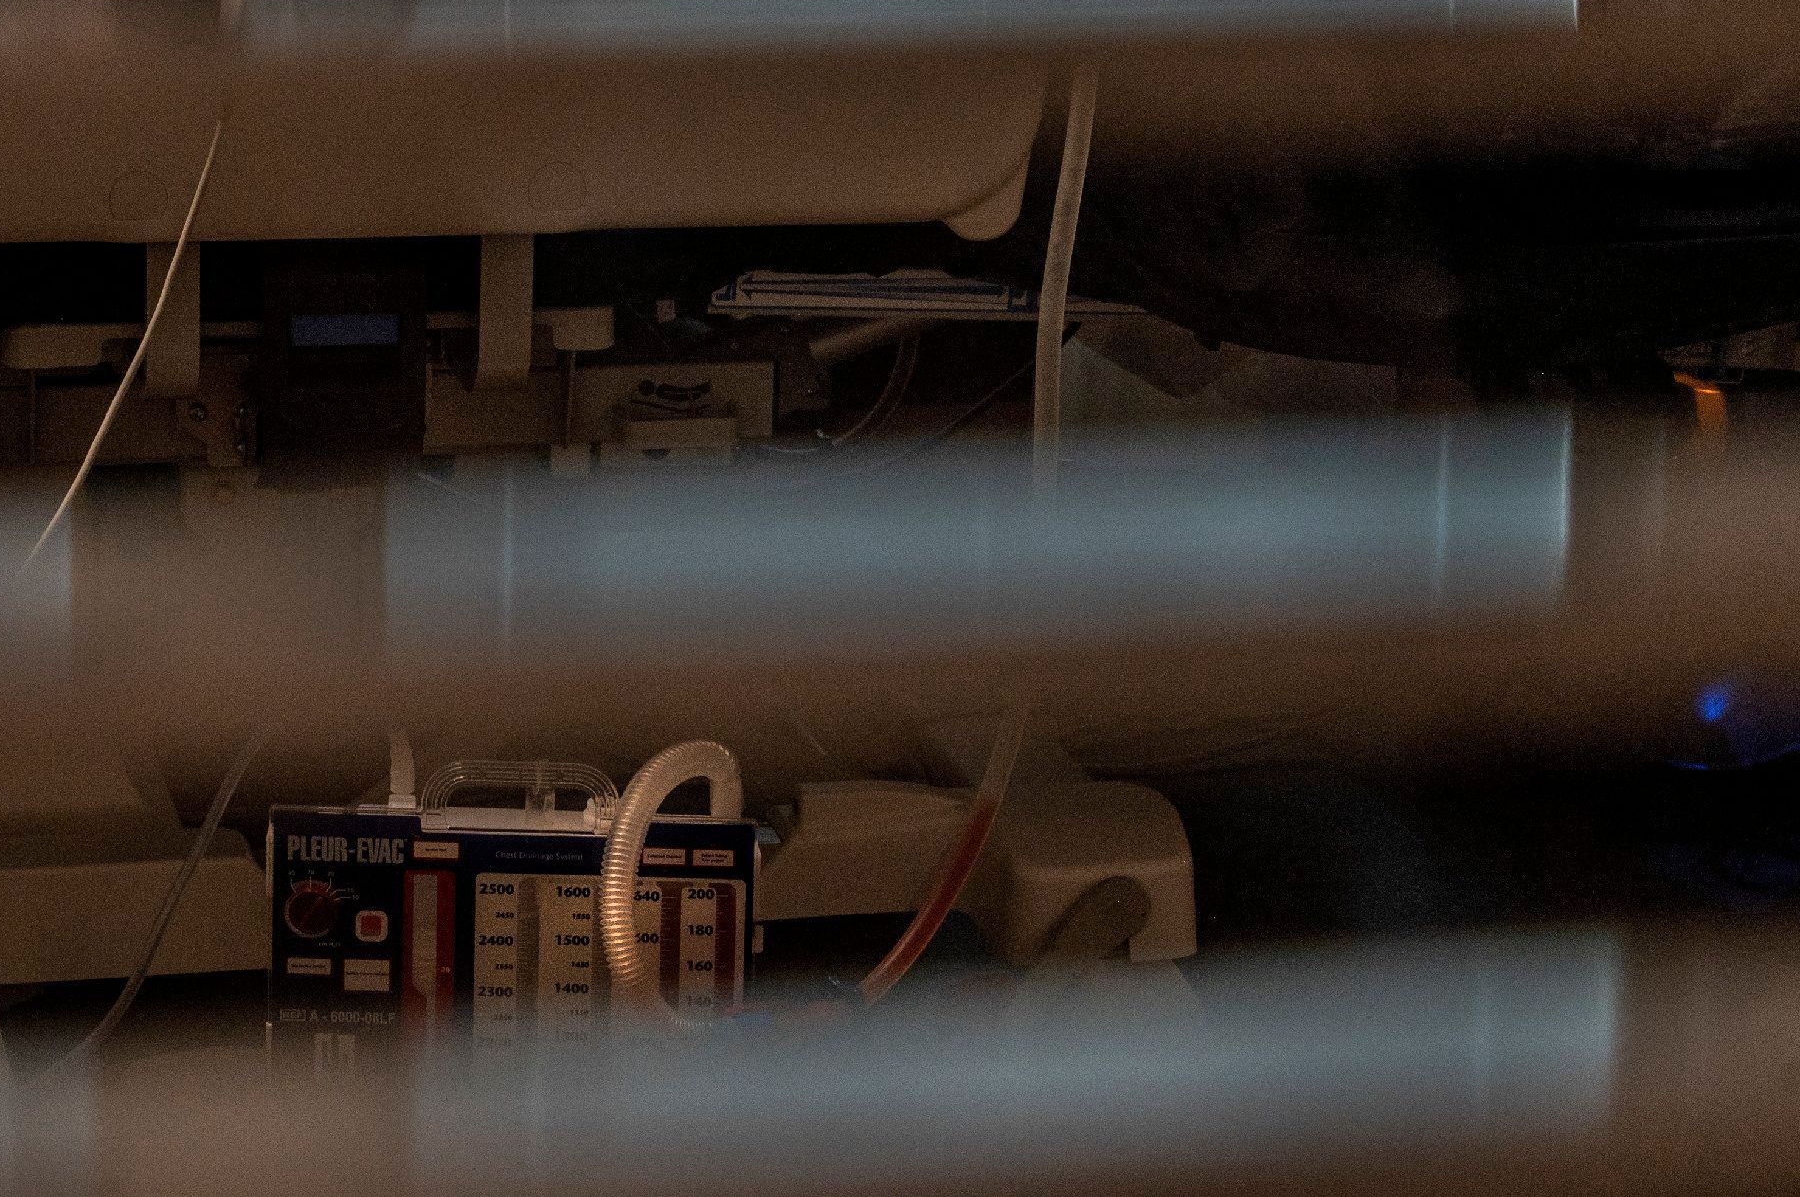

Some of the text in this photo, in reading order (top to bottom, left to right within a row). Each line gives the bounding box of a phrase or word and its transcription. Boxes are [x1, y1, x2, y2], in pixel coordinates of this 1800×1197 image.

[286, 834, 405, 865] PLEUR-EVAC
[479, 883, 515, 896] 2500
[556, 886, 591, 898] 1600
[688, 888, 715, 900] 200
[687, 924, 714, 936] 180
[478, 934, 514, 947] 2400
[555, 934, 590, 946] 1500
[686, 960, 713, 972] 160
[478, 986, 514, 998] 2300
[554, 982, 589, 994] 1400
